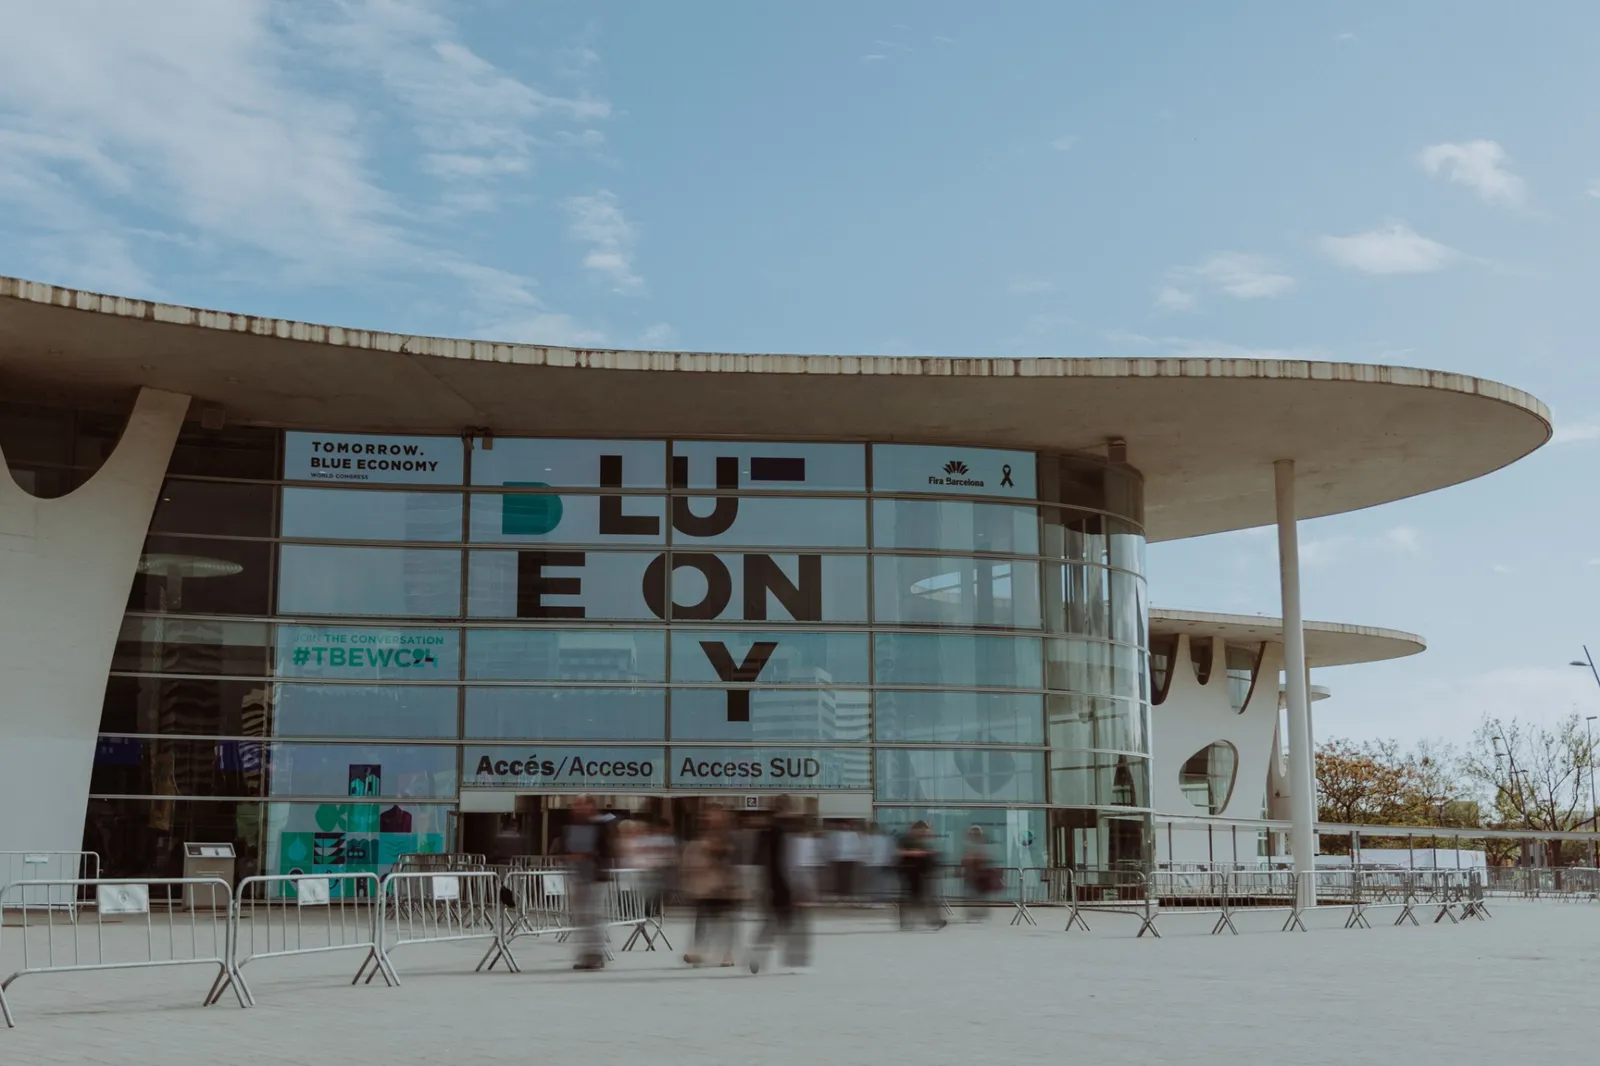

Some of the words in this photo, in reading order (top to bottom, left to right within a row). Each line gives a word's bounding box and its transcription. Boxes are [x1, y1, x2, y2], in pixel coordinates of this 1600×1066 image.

[311, 441, 424, 456] TOMORROW.
[311, 457, 351, 469] BLUE
[357, 459, 438, 472] ECONOMY
[928, 476, 944, 485] Fira
[945, 477, 984, 487] Barcelona
[294, 634, 320, 644] JOIN
[325, 634, 346, 643] THE
[350, 635, 444, 645] CONVERSATION
[680, 757, 763, 777] Access
[770, 758, 820, 778] SUD
